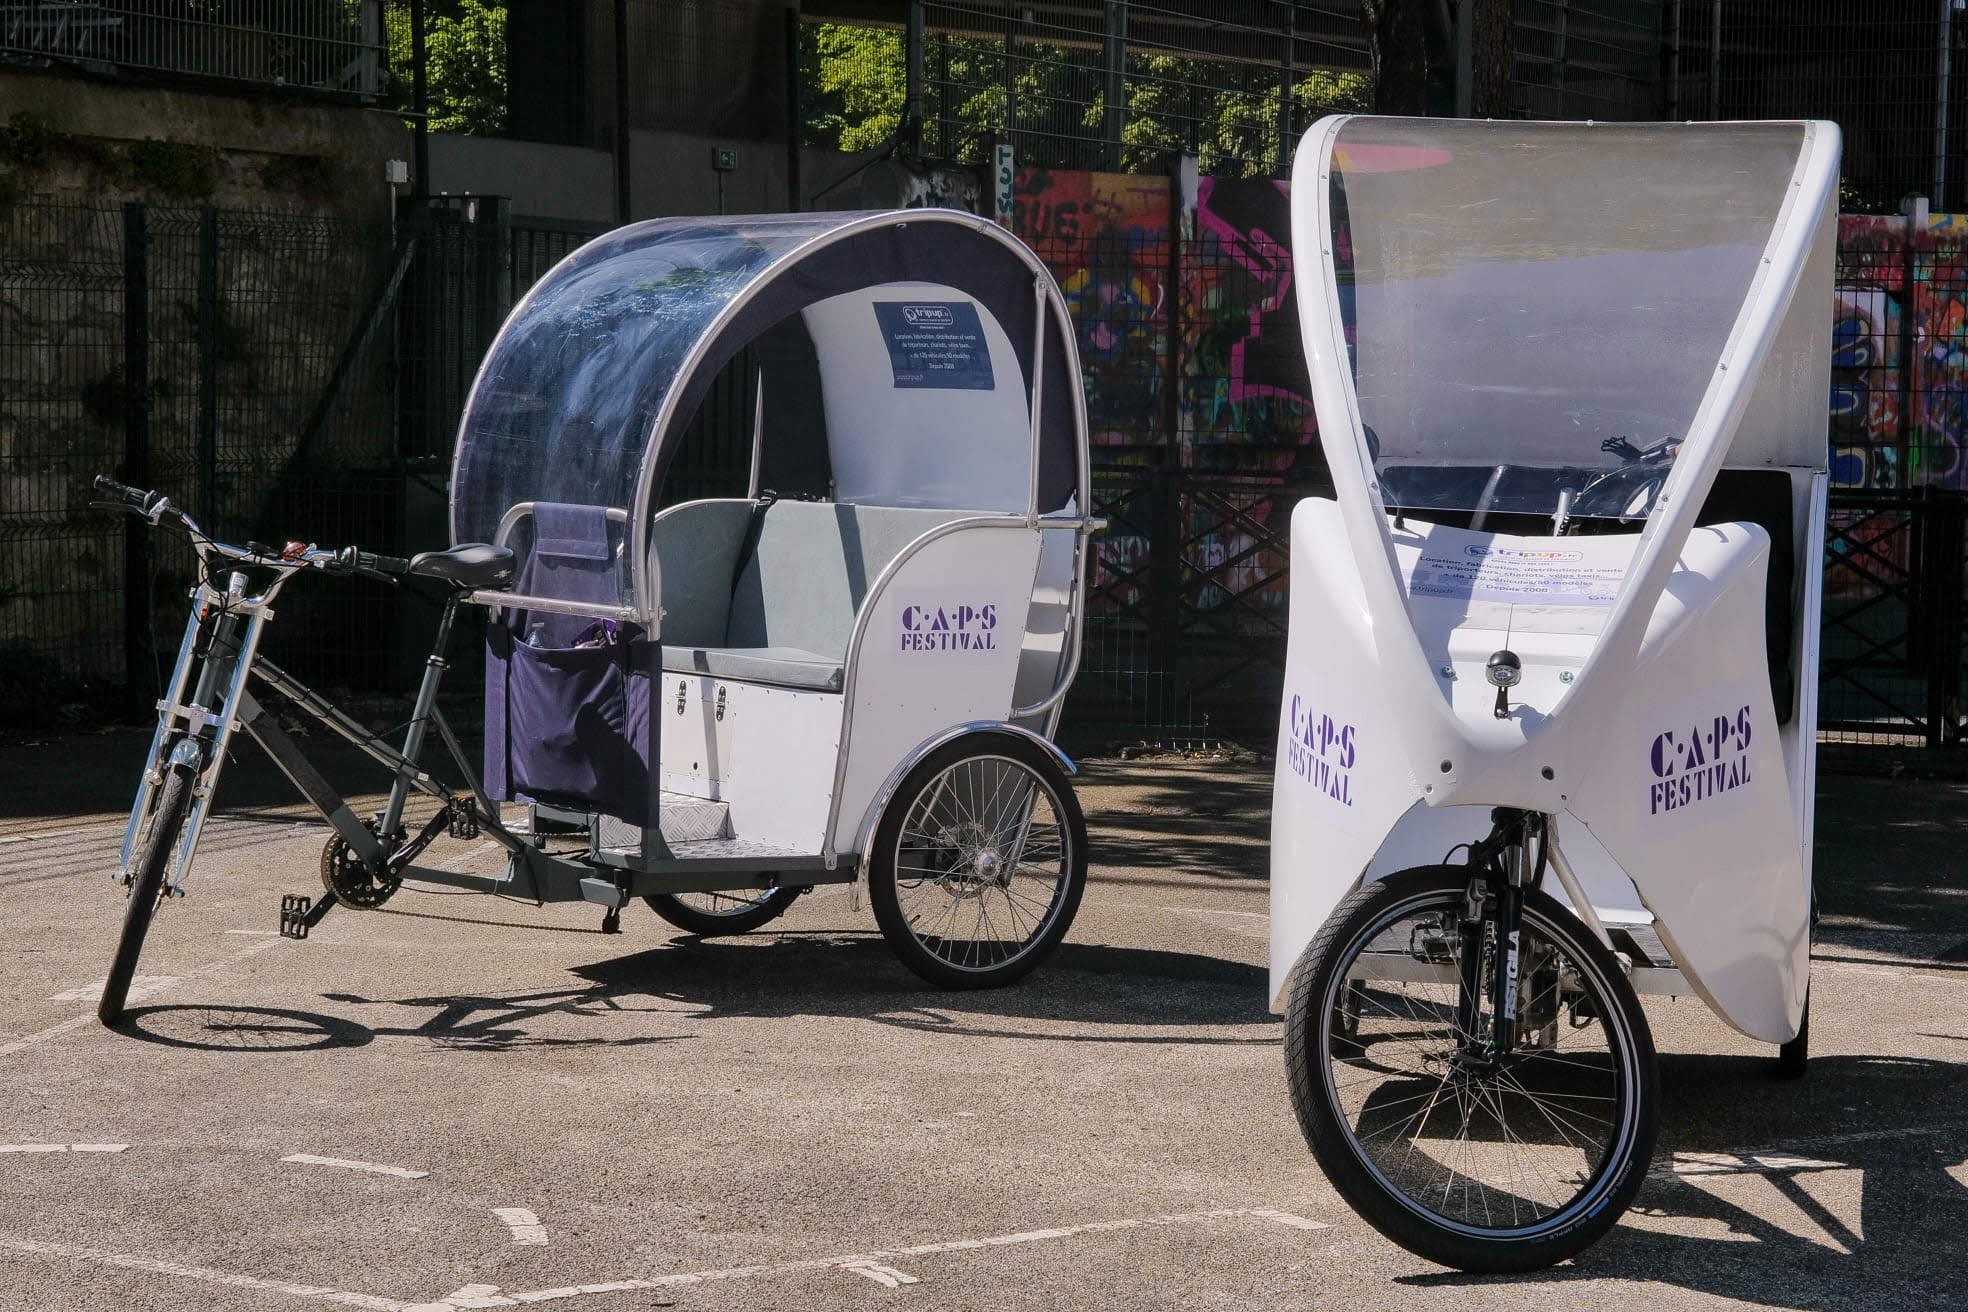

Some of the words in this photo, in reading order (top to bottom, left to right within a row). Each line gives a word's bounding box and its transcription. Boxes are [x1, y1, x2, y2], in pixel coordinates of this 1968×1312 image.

[1419, 556, 1464, 566] Location,
[1485, 584, 1520, 592] Depuis
[901, 632, 996, 650] FESTIVAL
[1288, 736, 1353, 807] FESTIVAL
[1650, 755, 1752, 815] FESTIVAL
